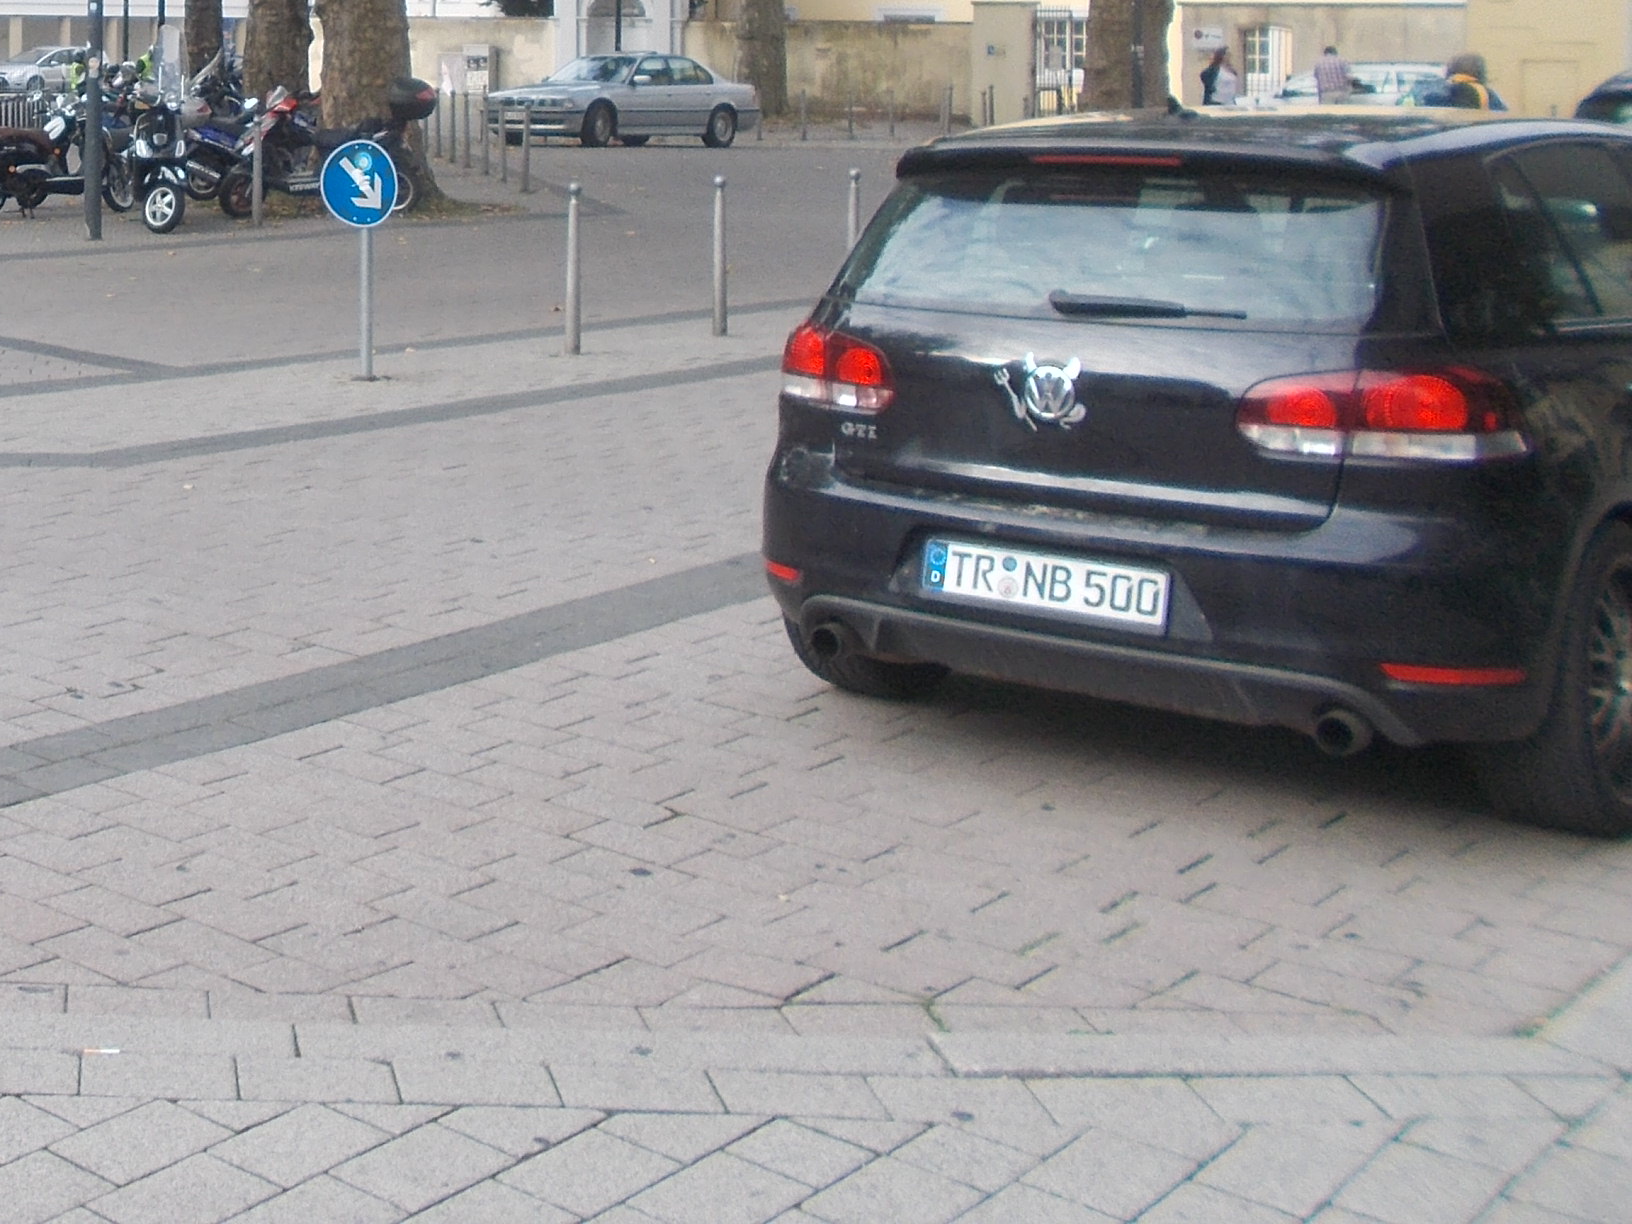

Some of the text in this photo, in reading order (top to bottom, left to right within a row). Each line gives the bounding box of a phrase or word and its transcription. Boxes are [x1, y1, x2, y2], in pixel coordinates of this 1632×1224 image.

[841, 422, 878, 439] GTI
[951, 551, 996, 592] TR
[1022, 561, 1073, 603] NB
[1083, 569, 1160, 617] 500
